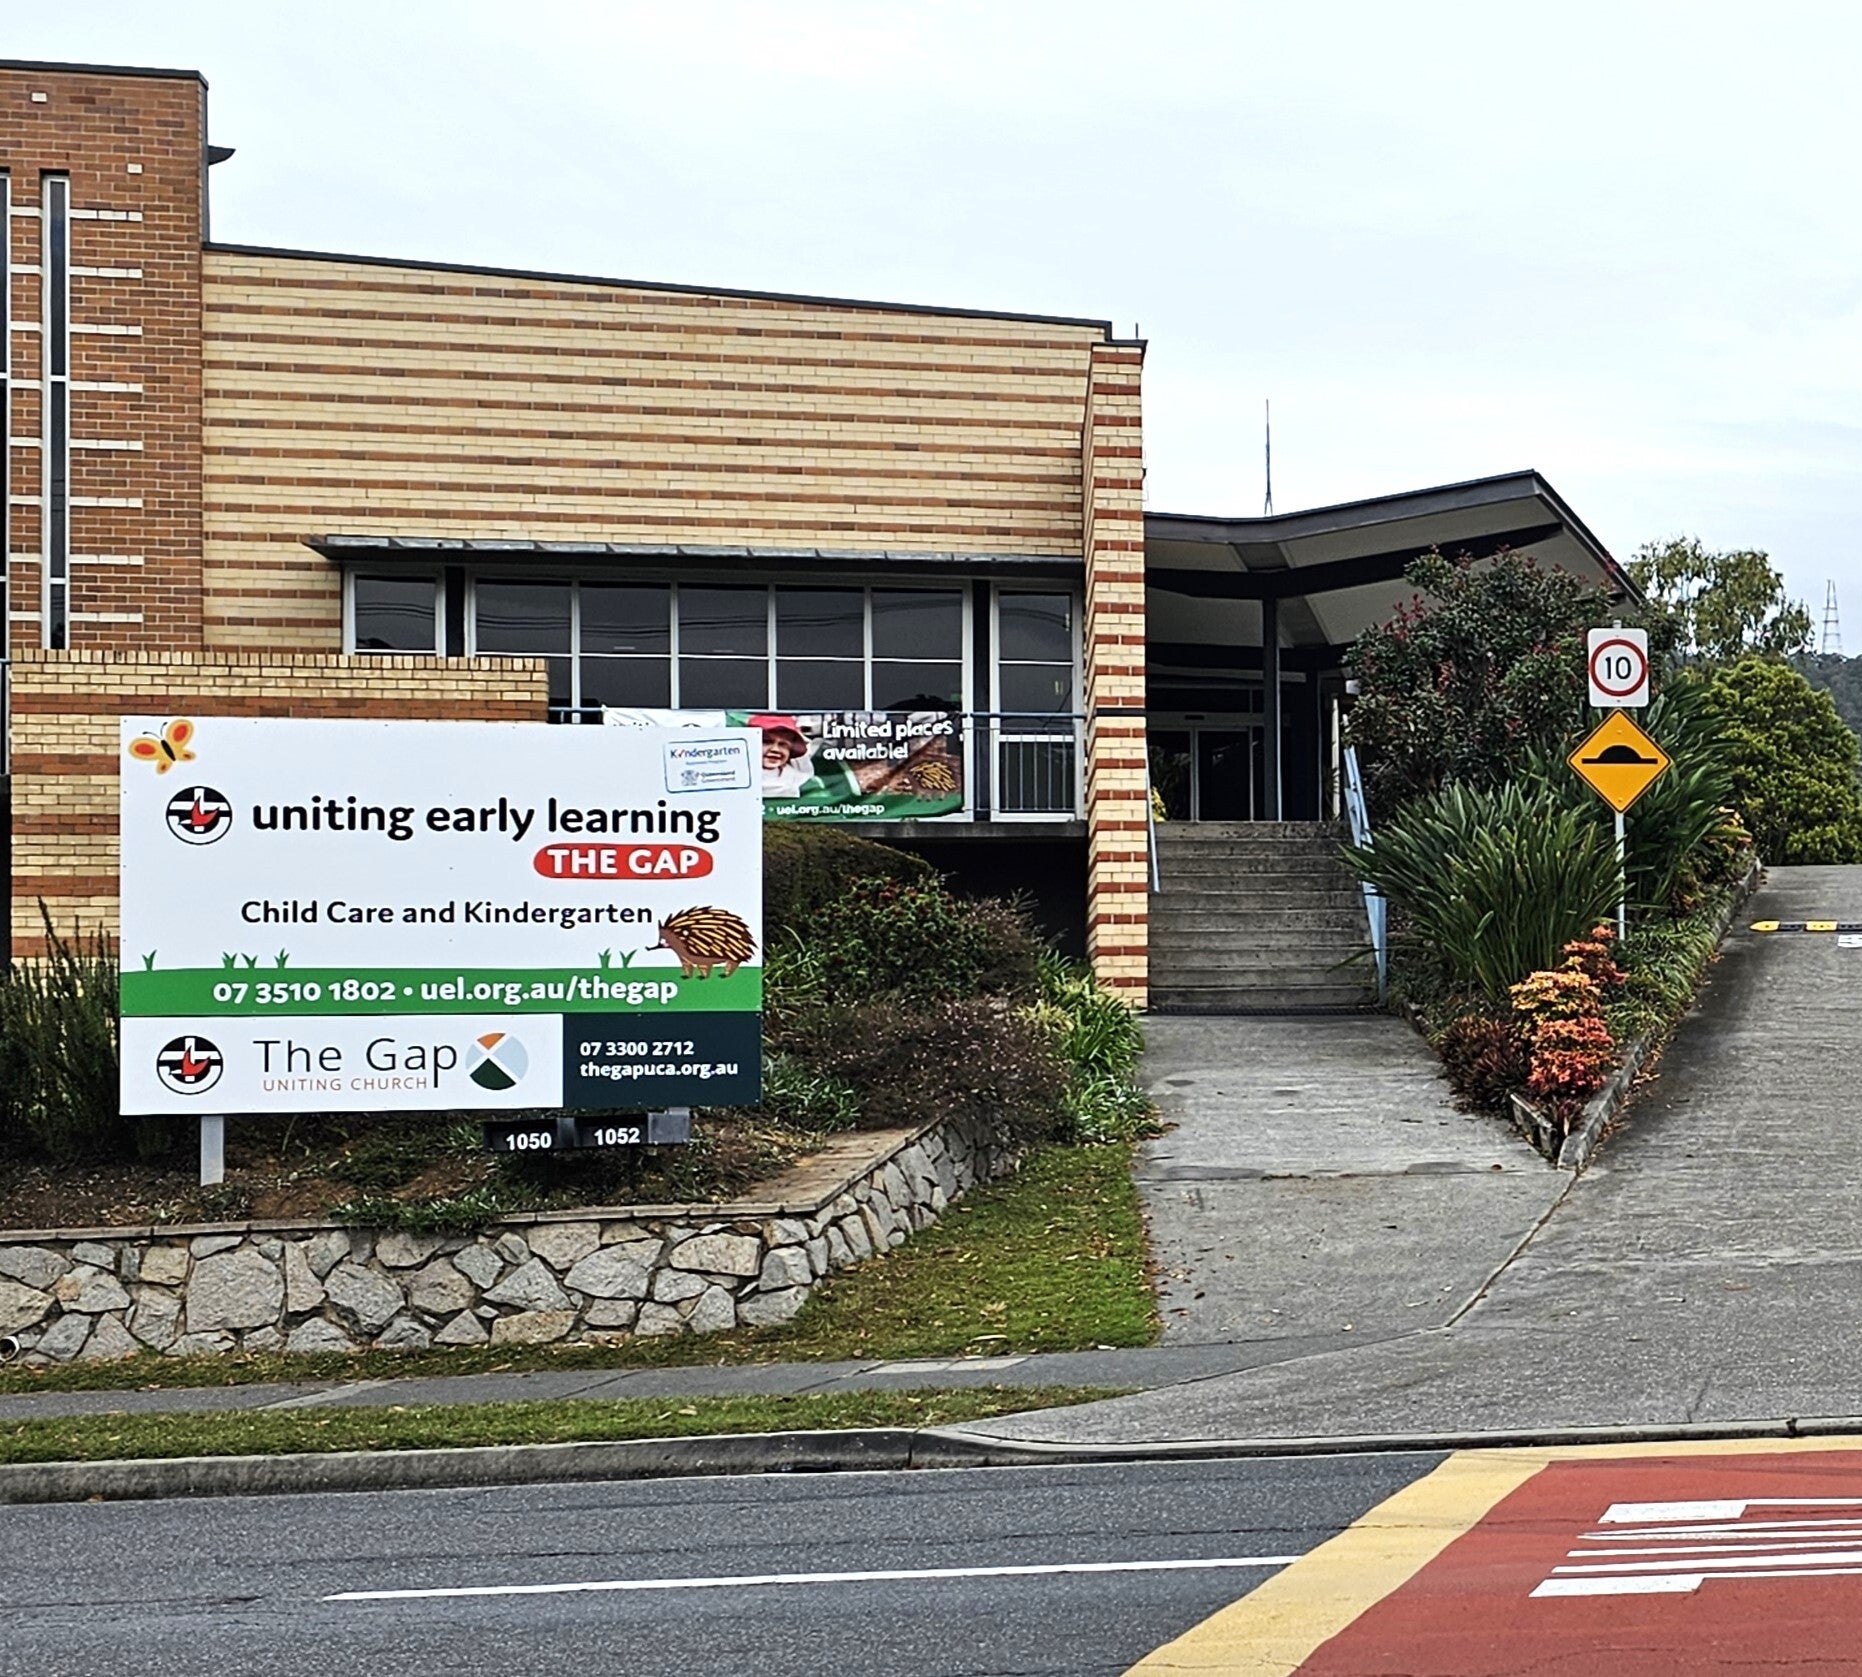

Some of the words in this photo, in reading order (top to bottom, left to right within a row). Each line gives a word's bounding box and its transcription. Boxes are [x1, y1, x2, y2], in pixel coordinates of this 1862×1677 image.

[1604, 655, 1633, 681] 10
[823, 720, 893, 739] Limited
[895, 721, 954, 741] places
[822, 743, 909, 761] available!
[253, 795, 415, 841] uniting
[426, 797, 535, 842] early
[548, 797, 721, 844] learning
[546, 848, 618, 874] THE
[627, 848, 701, 874] GAP
[241, 900, 318, 923] Child
[326, 901, 394, 923] Care
[402, 900, 455, 923] and
[465, 901, 652, 930] Kindergarten
[213, 983, 249, 1004] 07
[255, 982, 322, 1004] 3510
[328, 979, 396, 1001] 1802
[421, 975, 678, 1006] uel.org.au/thegap
[580, 1041, 602, 1056] 07
[605, 1041, 648, 1056] 3300
[652, 1040, 695, 1056] 2712
[252, 1040, 342, 1073] The
[366, 1037, 457, 1089] Gap
[580, 1061, 738, 1081] thegapuca.org.au
[263, 1078, 342, 1092] UNITING
[350, 1076, 427, 1091] CHURCH
[506, 1132, 552, 1151] 1050
[594, 1127, 640, 1146] 1052
